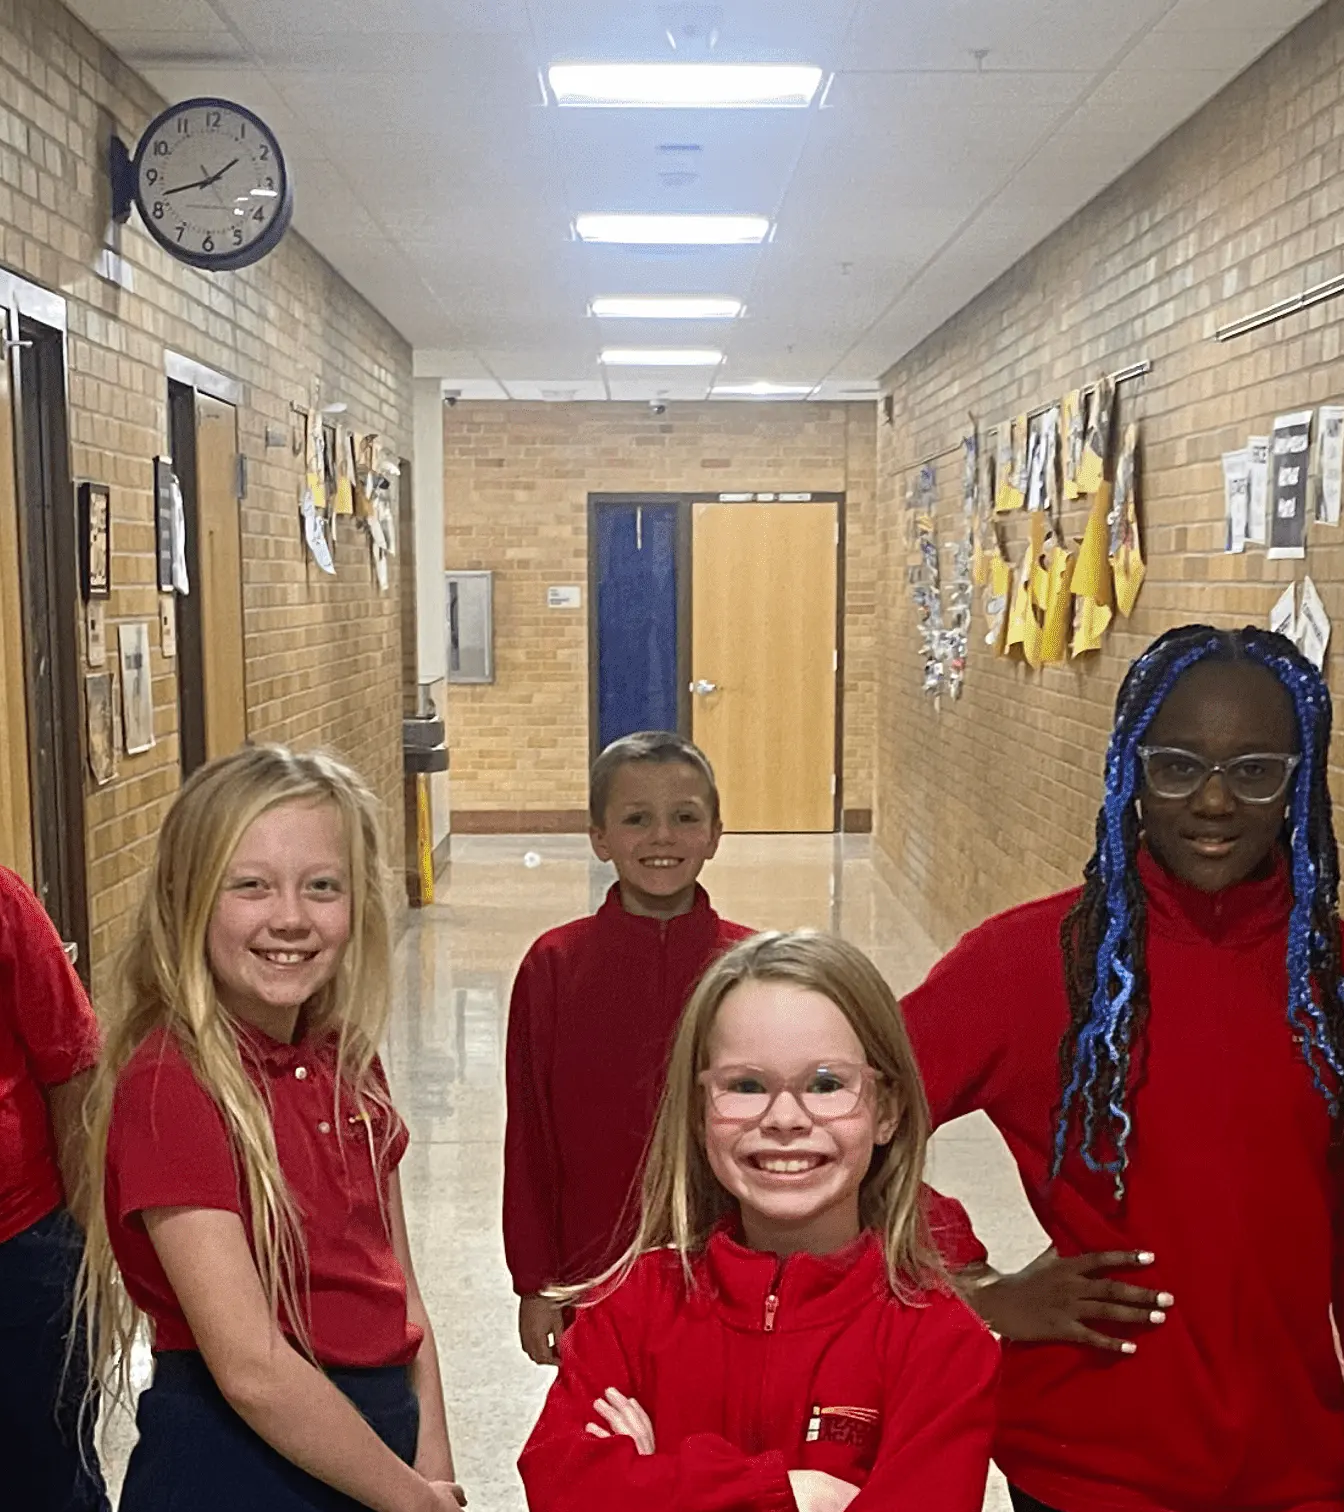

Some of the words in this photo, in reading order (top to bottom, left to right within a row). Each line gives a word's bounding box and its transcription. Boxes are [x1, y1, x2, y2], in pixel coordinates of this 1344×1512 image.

[177, 118, 189, 134] 11
[205, 111, 222, 128] 12
[240, 122, 246, 140] 1
[153, 140, 169, 156] 10
[258, 143, 270, 161] 2
[145, 168, 159, 187] 9
[265, 176, 275, 193] 3
[152, 200, 165, 219] 8
[251, 205, 265, 223] 4
[174, 226, 186, 243] 7
[232, 229, 243, 247] 5
[201, 235, 215, 252] 6
